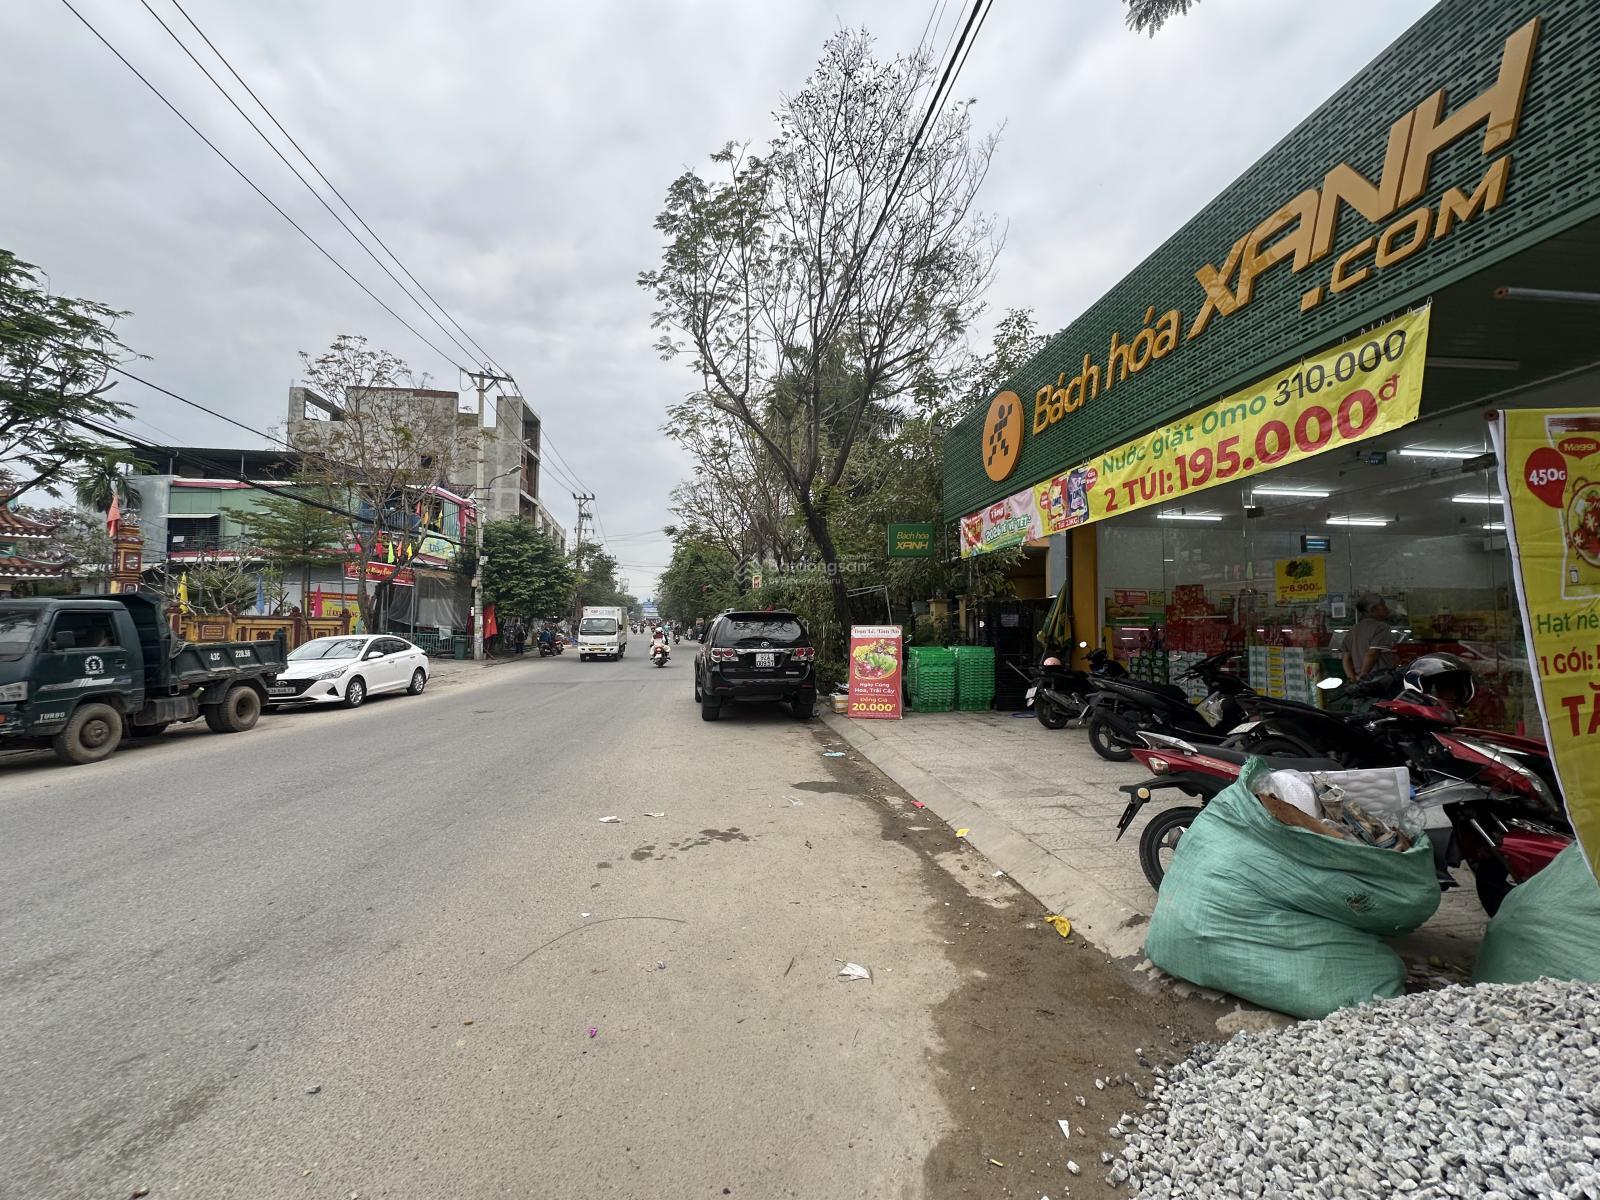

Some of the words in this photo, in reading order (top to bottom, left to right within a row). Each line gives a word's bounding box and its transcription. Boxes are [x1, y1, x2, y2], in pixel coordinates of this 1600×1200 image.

[1033, 353, 1101, 436] Bách
[1106, 305, 1181, 391] hóa
[1187, 16, 1541, 340] XANH
[1301, 155, 1511, 312] .COM
[1102, 449, 1147, 476] Nước
[1152, 421, 1194, 459] giặt
[1201, 395, 1267, 435] Omo
[1273, 329, 1407, 407] 310.000
[1563, 443, 1597, 452] Maggi
[1529, 468, 1566, 485] 450G
[1104, 487, 1118, 512] 2
[895, 541, 929, 550] XANH
[896, 532, 915, 540] Bách
[1537, 613, 1571, 638] Hạt
[1541, 655, 1549, 676] 1
[1553, 646, 1593, 674] GÓI:
[40, 712, 66, 720] TURBO
